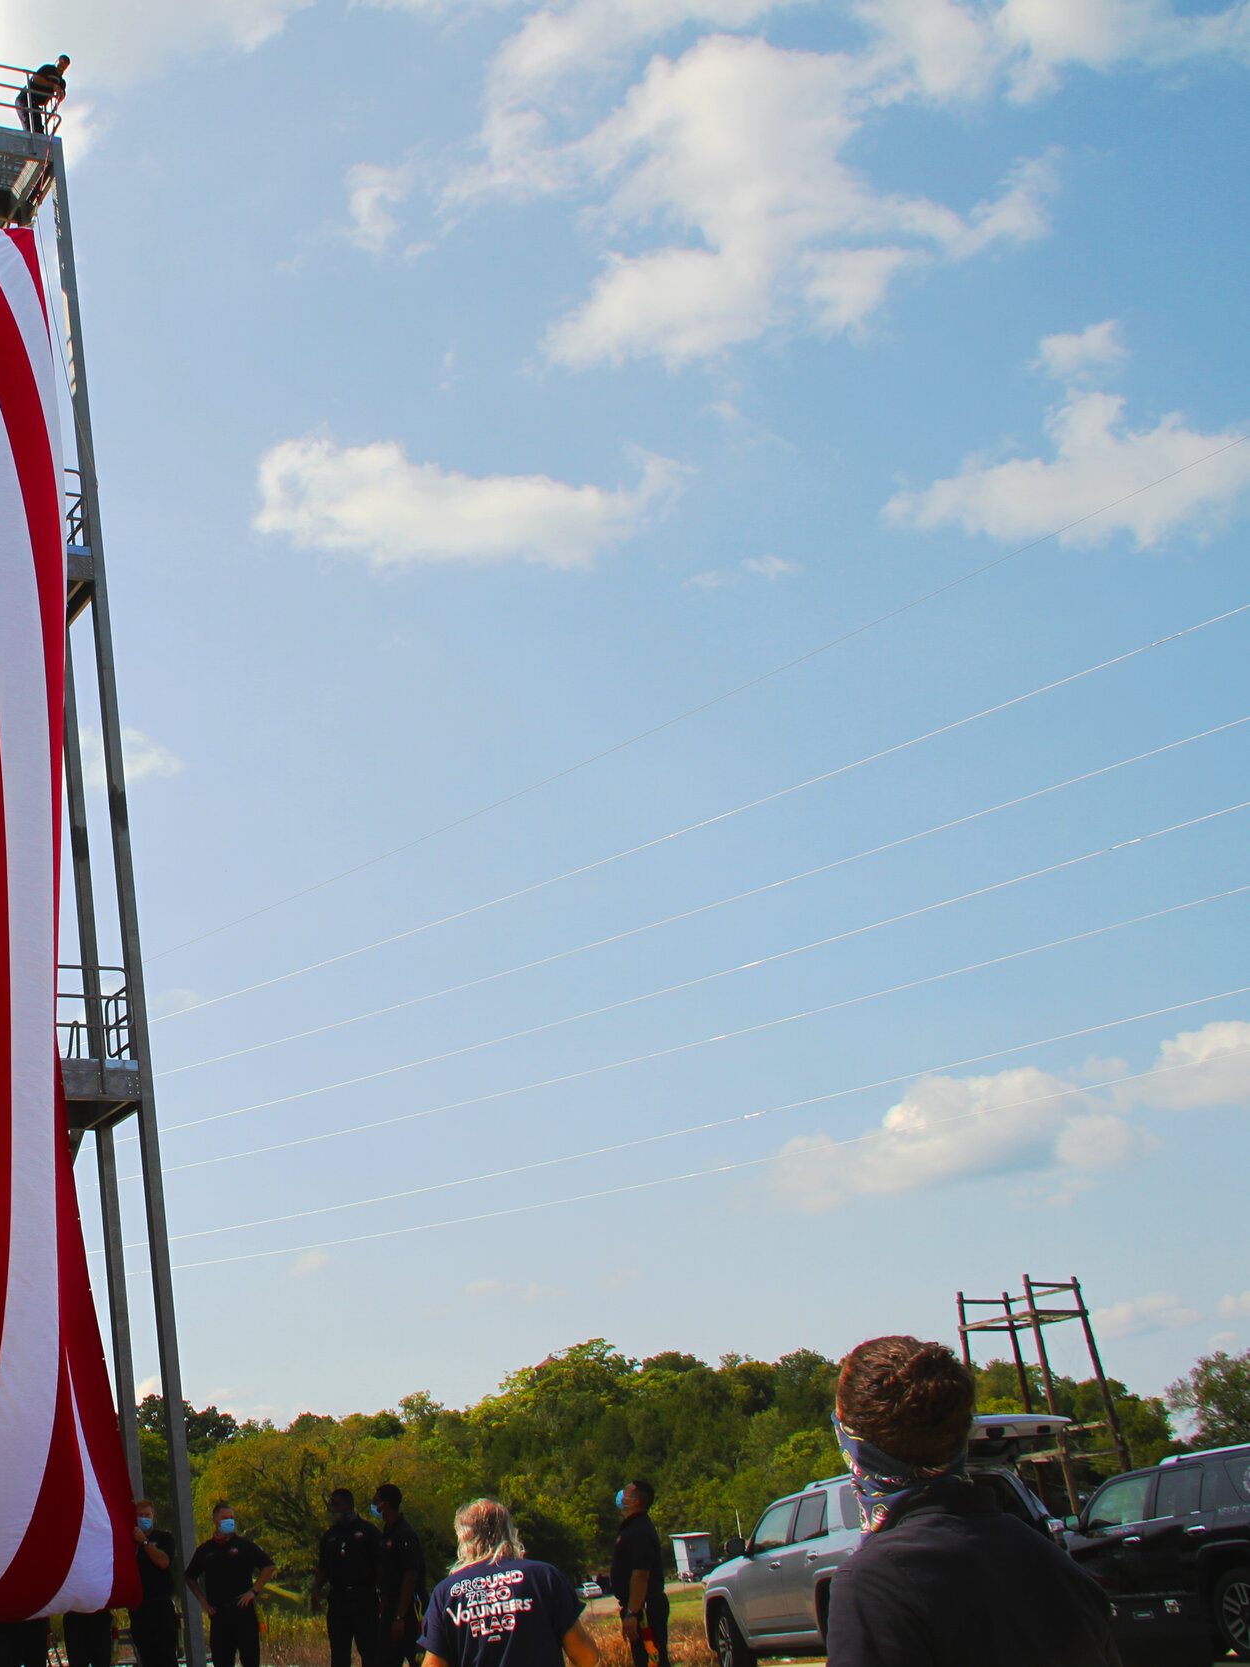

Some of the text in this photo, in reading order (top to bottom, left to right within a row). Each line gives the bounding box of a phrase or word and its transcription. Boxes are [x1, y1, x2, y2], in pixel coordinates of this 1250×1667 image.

[450, 1569, 524, 1597] GROUND
[465, 1585, 511, 1607] ZERO
[470, 1613, 516, 1638] FLAG
